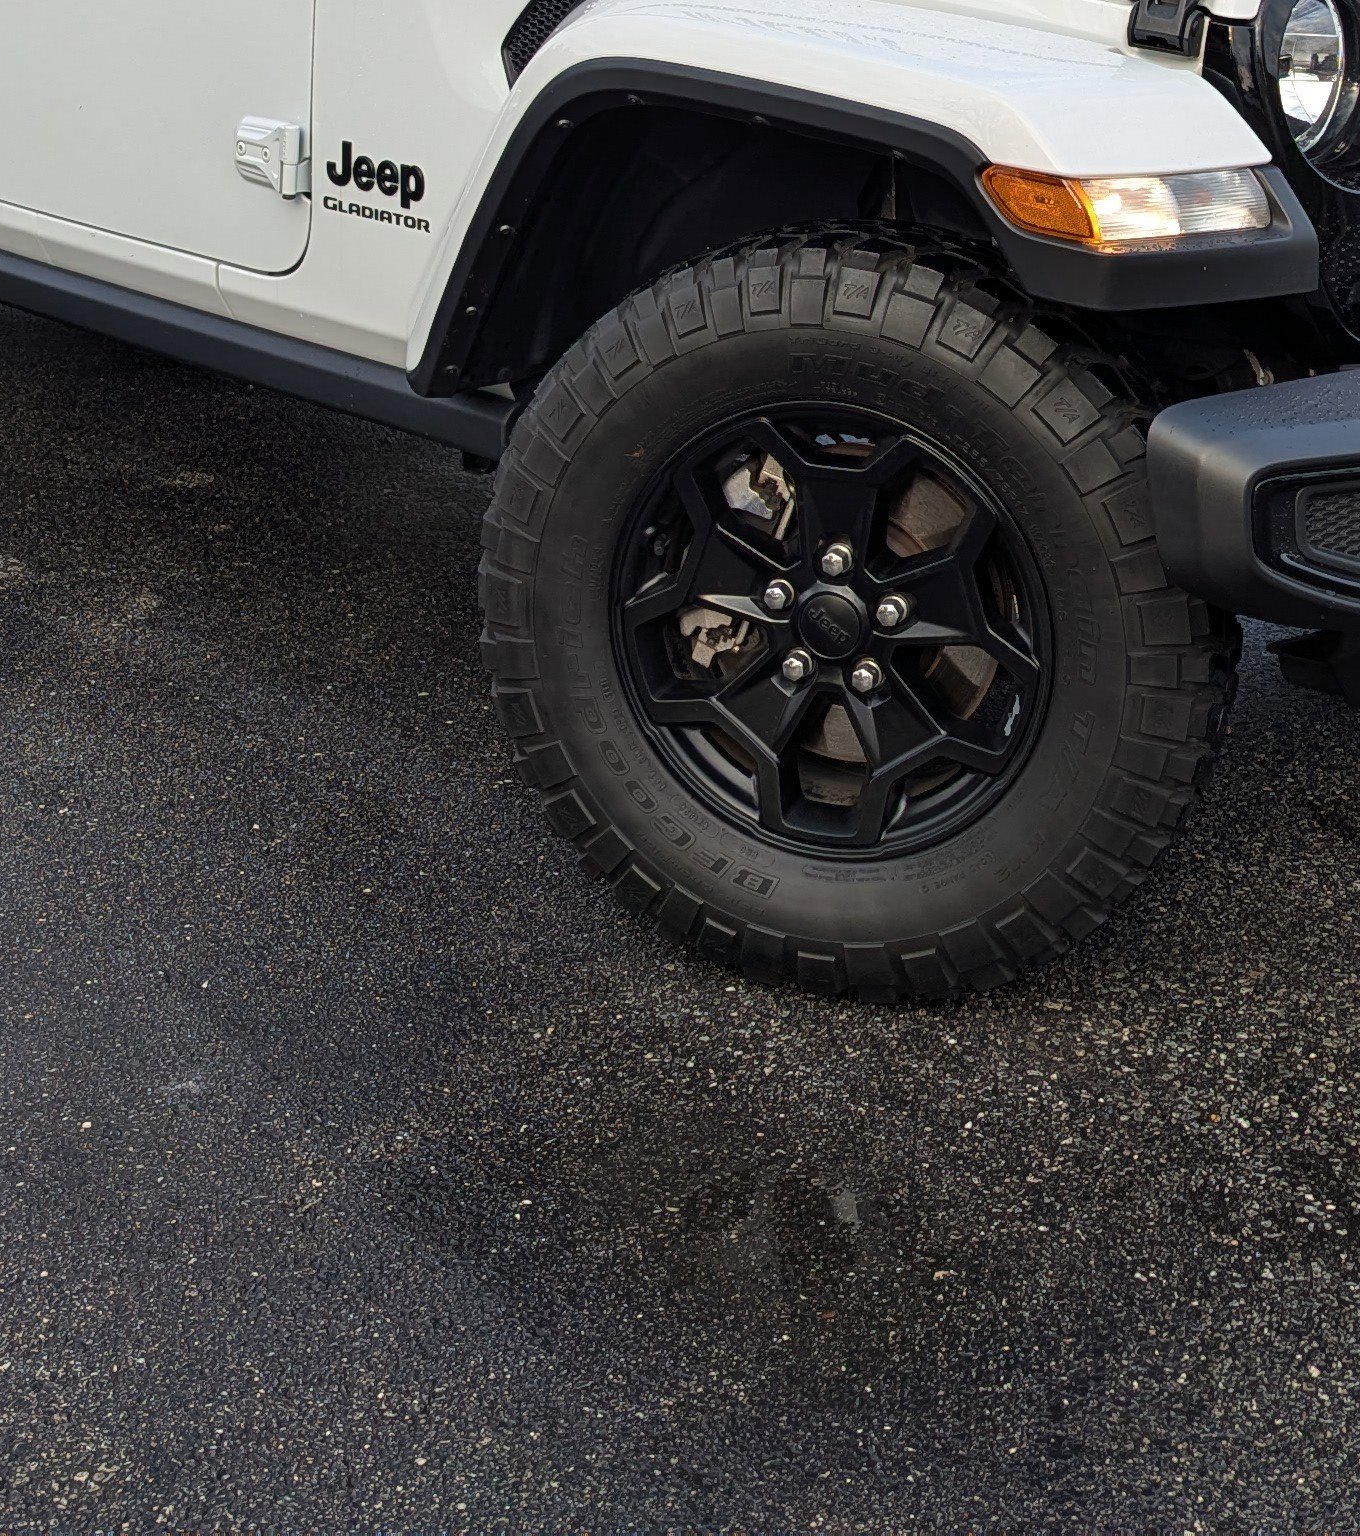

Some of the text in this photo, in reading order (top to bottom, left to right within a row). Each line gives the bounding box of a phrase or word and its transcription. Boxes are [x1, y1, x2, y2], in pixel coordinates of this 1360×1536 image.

[326, 140, 425, 210] Jeep
[323, 196, 430, 233] GLADIATOR
[808, 608, 851, 643] Jeep
